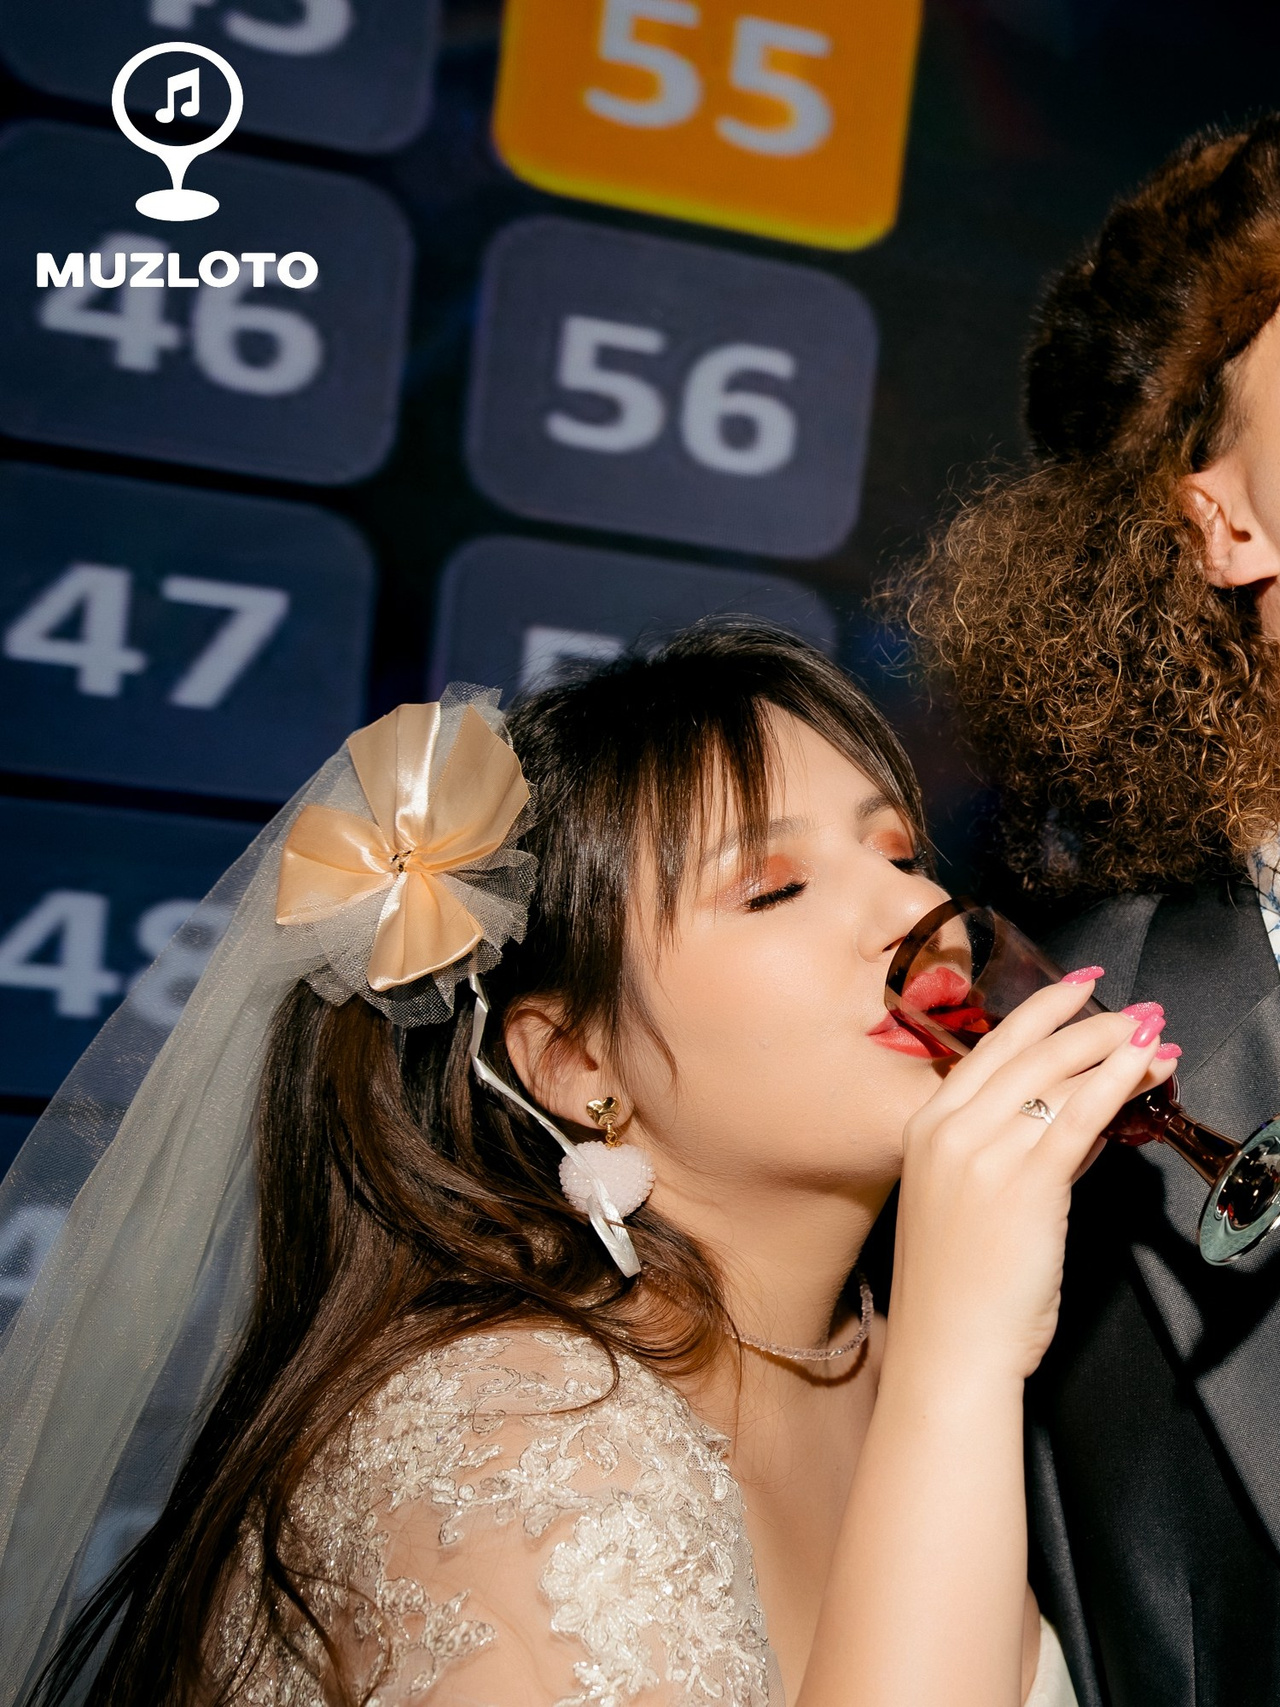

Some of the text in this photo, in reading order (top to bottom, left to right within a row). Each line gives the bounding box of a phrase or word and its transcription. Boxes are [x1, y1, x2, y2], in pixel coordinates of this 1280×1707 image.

[584, 0, 834, 157] 55
[39, 230, 323, 396] 46
[546, 316, 798, 477] 56
[4, 563, 290, 710] 47
